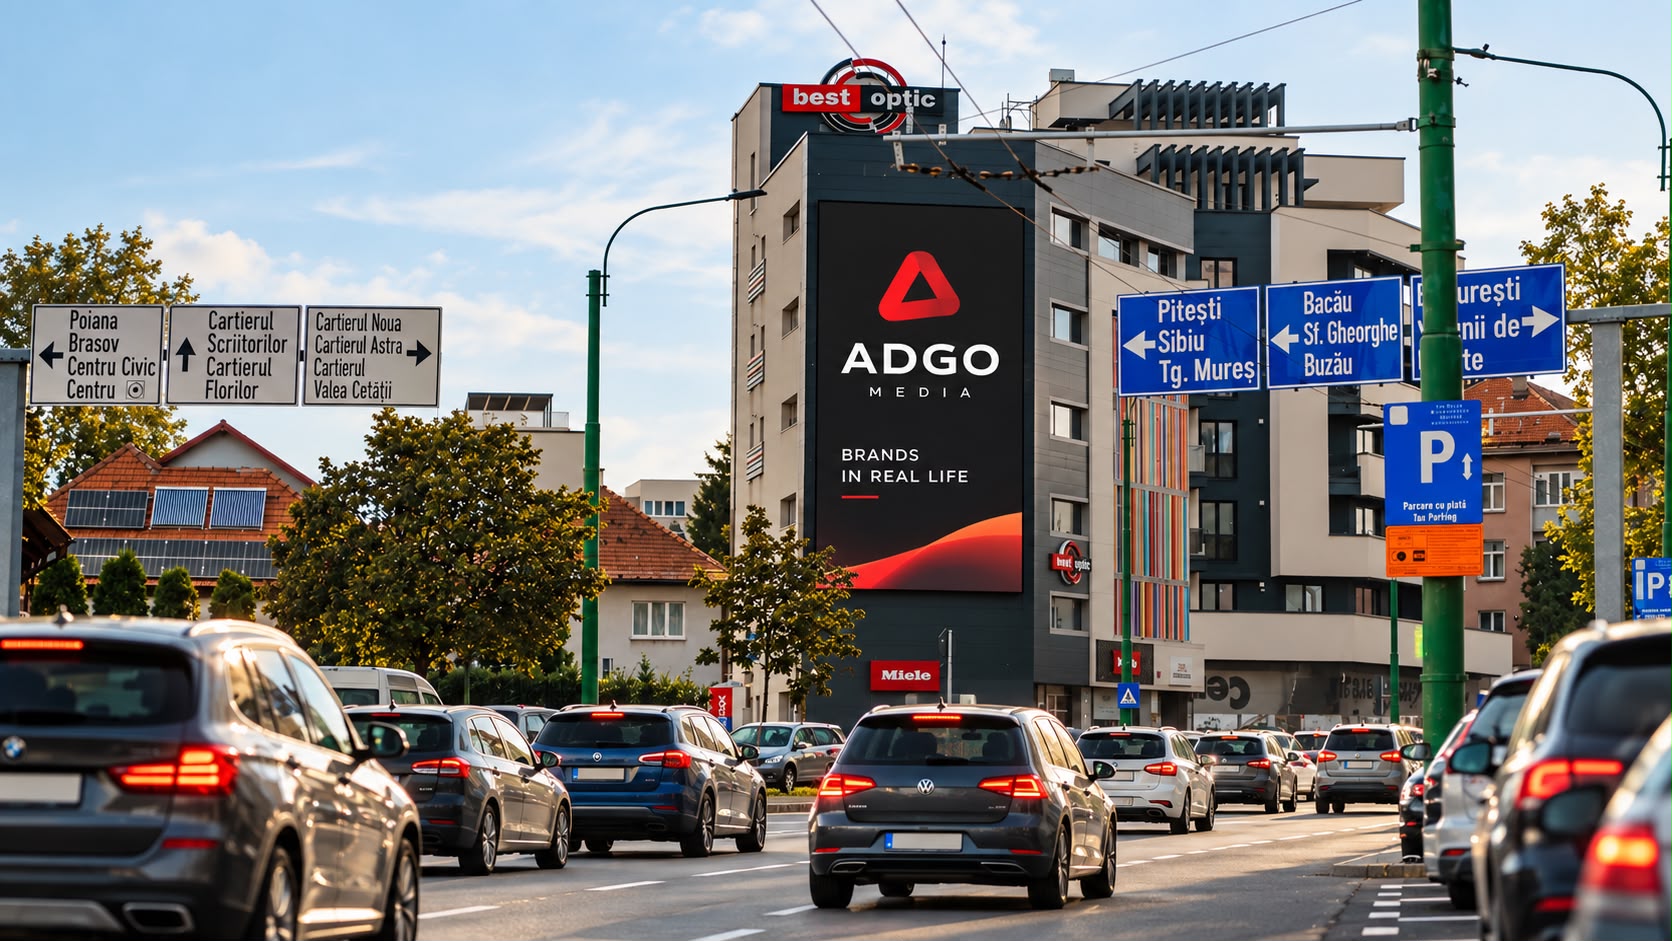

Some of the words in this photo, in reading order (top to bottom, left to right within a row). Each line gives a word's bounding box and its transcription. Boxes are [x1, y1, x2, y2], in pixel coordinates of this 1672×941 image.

[794, 88, 850, 105] best
[870, 90, 936, 110] optic
[1159, 295, 1221, 325] Pitești
[1304, 291, 1351, 314] Bacău
[70, 310, 117, 329] Poiana
[209, 311, 273, 330] Cartierul
[316, 312, 367, 331] Cartierul
[372, 313, 401, 331] Noua
[1494, 313, 1519, 338] de
[69, 333, 119, 352] Brasov
[1159, 329, 1204, 353] Sibiu
[1304, 322, 1323, 345] Sf.
[1328, 318, 1397, 347] Gheorghe
[208, 333, 287, 353] Scriitorilor
[316, 335, 366, 354] Cartierul
[371, 336, 402, 354] Astra
[68, 356, 115, 376] Centru
[122, 357, 155, 376] Civic
[207, 356, 271, 376] Cartierul
[314, 357, 365, 376] Cartierul
[841, 343, 999, 375] ADGO
[1305, 352, 1352, 376] Buzău
[1159, 360, 1188, 388] Tg.
[1195, 358, 1254, 383] Mureș
[68, 379, 115, 399] Centru
[206, 380, 258, 399] Florilor
[315, 380, 347, 398] Valea
[353, 380, 391, 402] Cetății
[870, 387, 970, 397] MEDIA
[843, 449, 918, 461] BRANDS
[1421, 431, 1455, 483] P
[843, 470, 860, 482] IN
[871, 470, 919, 482] REAL
[929, 470, 968, 482] LIFE
[881, 669, 931, 681] Miele
